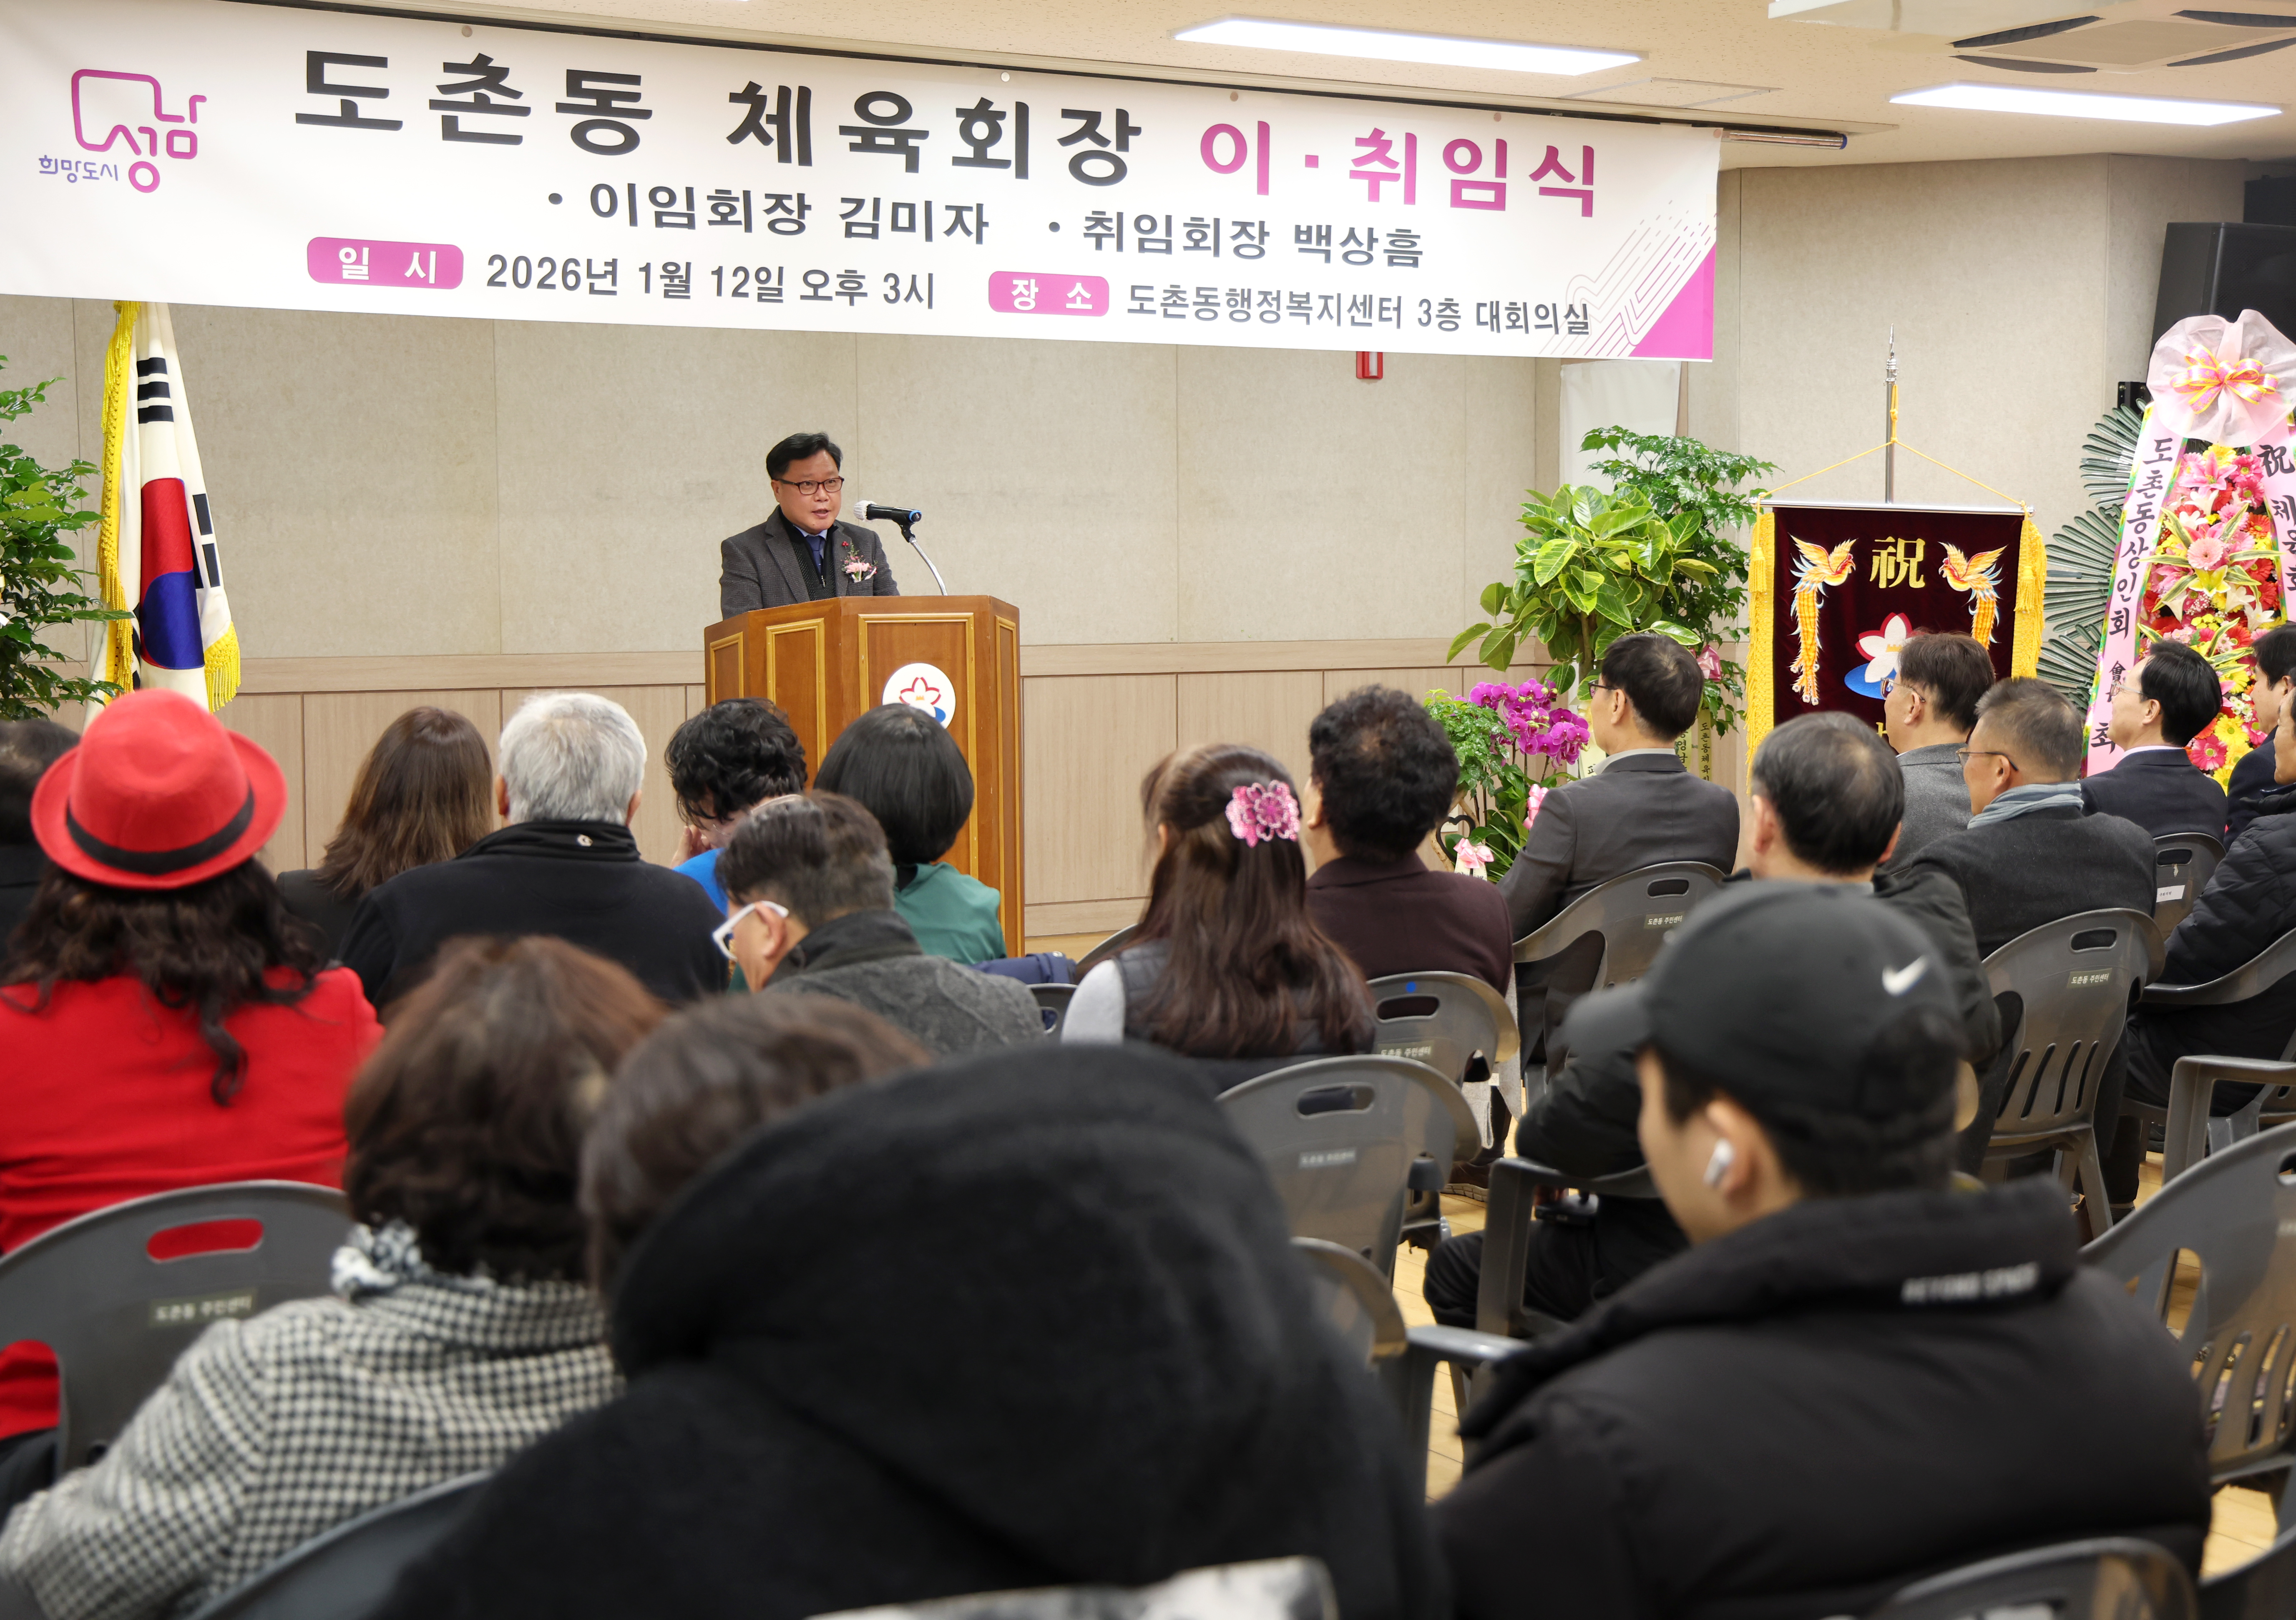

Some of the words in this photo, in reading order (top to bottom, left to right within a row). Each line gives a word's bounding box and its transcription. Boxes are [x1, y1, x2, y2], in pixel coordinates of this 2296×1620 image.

[295, 50, 652, 156] 도촌동
[726, 80, 1142, 186] 체육회장
[38, 155, 118, 183] 희망도시
[590, 183, 812, 236] 이임회장
[839, 197, 989, 244] 김미자
[1083, 211, 1270, 259] 취임회장
[1294, 224, 1423, 268] 백상흠
[487, 254, 618, 296] 2026년
[639, 262, 692, 299] 1월
[711, 266, 784, 303] 12일
[800, 269, 868, 306] 오후
[883, 273, 933, 309] 3시
[1127, 284, 1402, 329] 도촌동행정복지센터
[1418, 298, 1461, 332] 3층
[1476, 301, 1589, 335] 대회의실
[2256, 445, 2296, 477] 祝
[1869, 536, 1926, 589] 祝
[2109, 438, 2173, 639] 도촌동상인회
[1664, 915, 1682, 924] 주민센터
[2090, 973, 2109, 983] 주민센터
